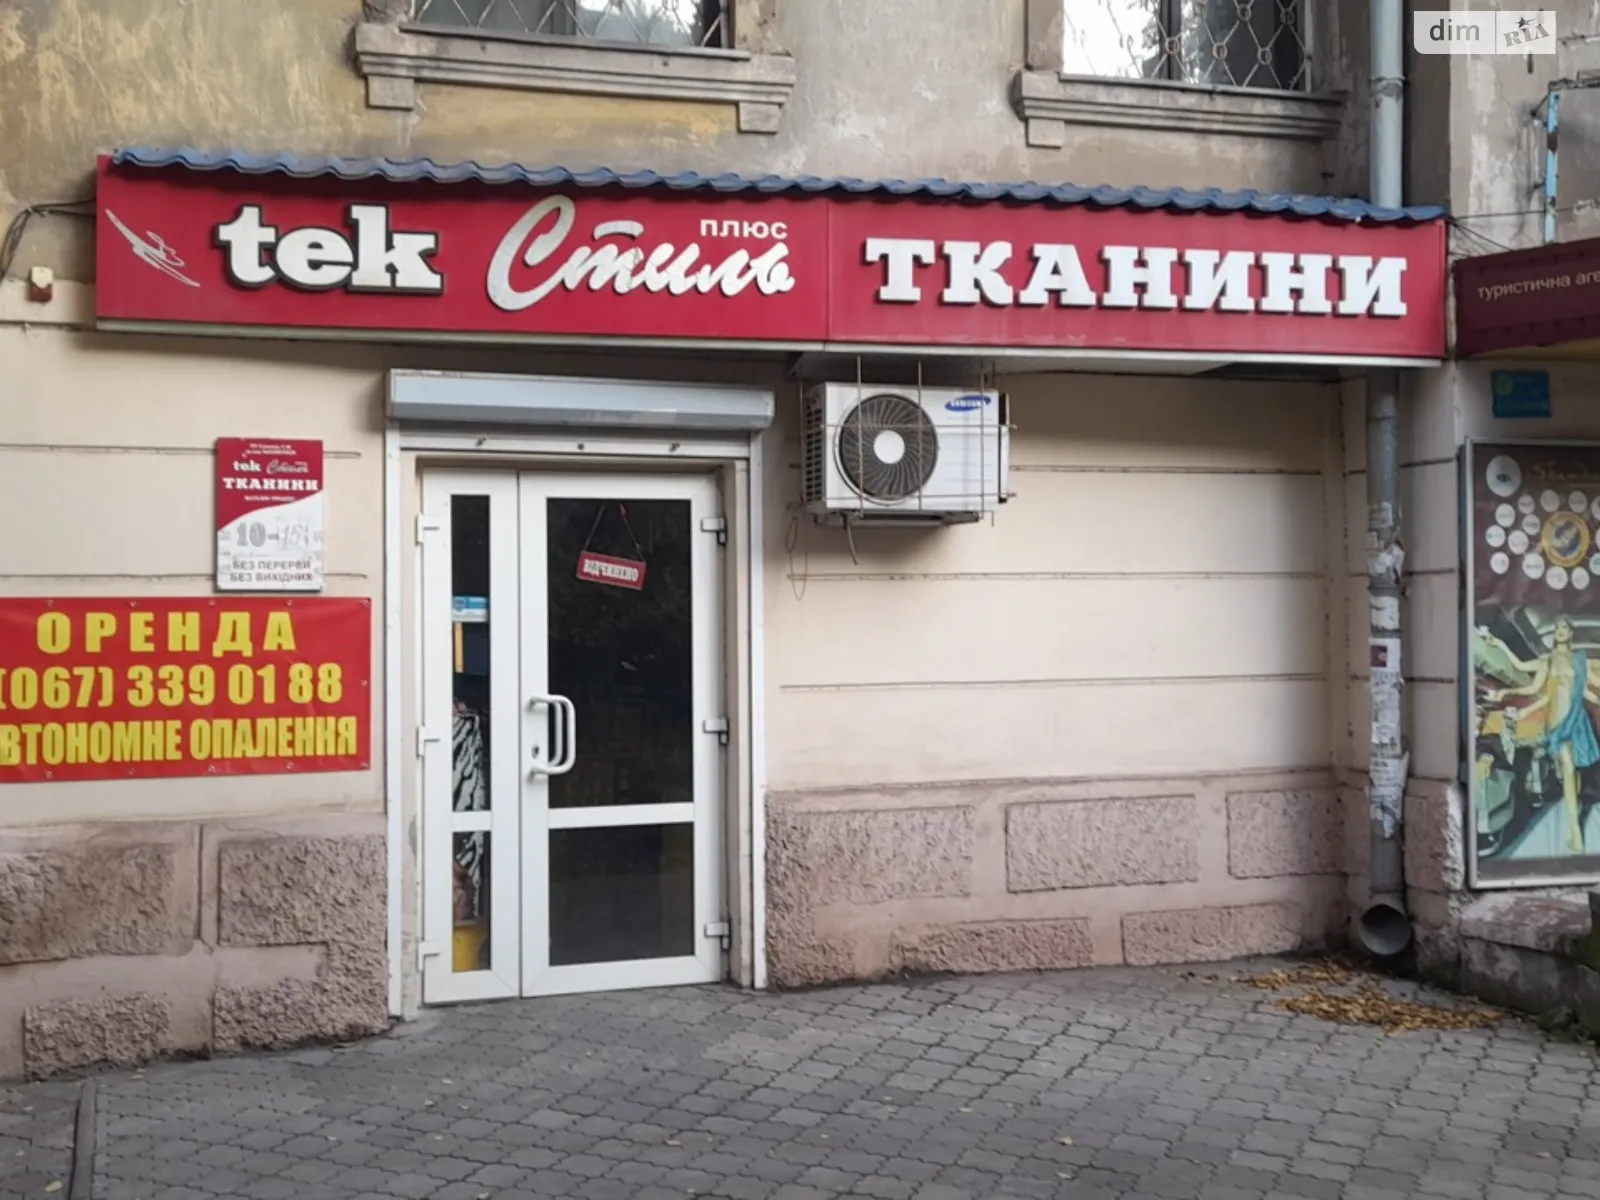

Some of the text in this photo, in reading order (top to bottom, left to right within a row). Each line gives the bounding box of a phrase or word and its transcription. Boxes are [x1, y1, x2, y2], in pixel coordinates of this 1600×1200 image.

[217, 204, 443, 293] tek
[487, 194, 796, 311] Стиль
[864, 237, 1408, 316] ТКАНИНИ
[1477, 275, 1571, 301] туристична
[222, 477, 319, 491] ТКАНИНИ
[230, 572, 253, 582] БЕЗ
[232, 559, 312, 570] БЕЗ ПЕРЕРВИ
[37, 611, 297, 657] ОРЕНДА
[127, 665, 215, 707] 339
[228, 664, 276, 704] 01
[288, 662, 343, 704] 88
[190, 716, 358, 761] ОПАЛЕННЯ
